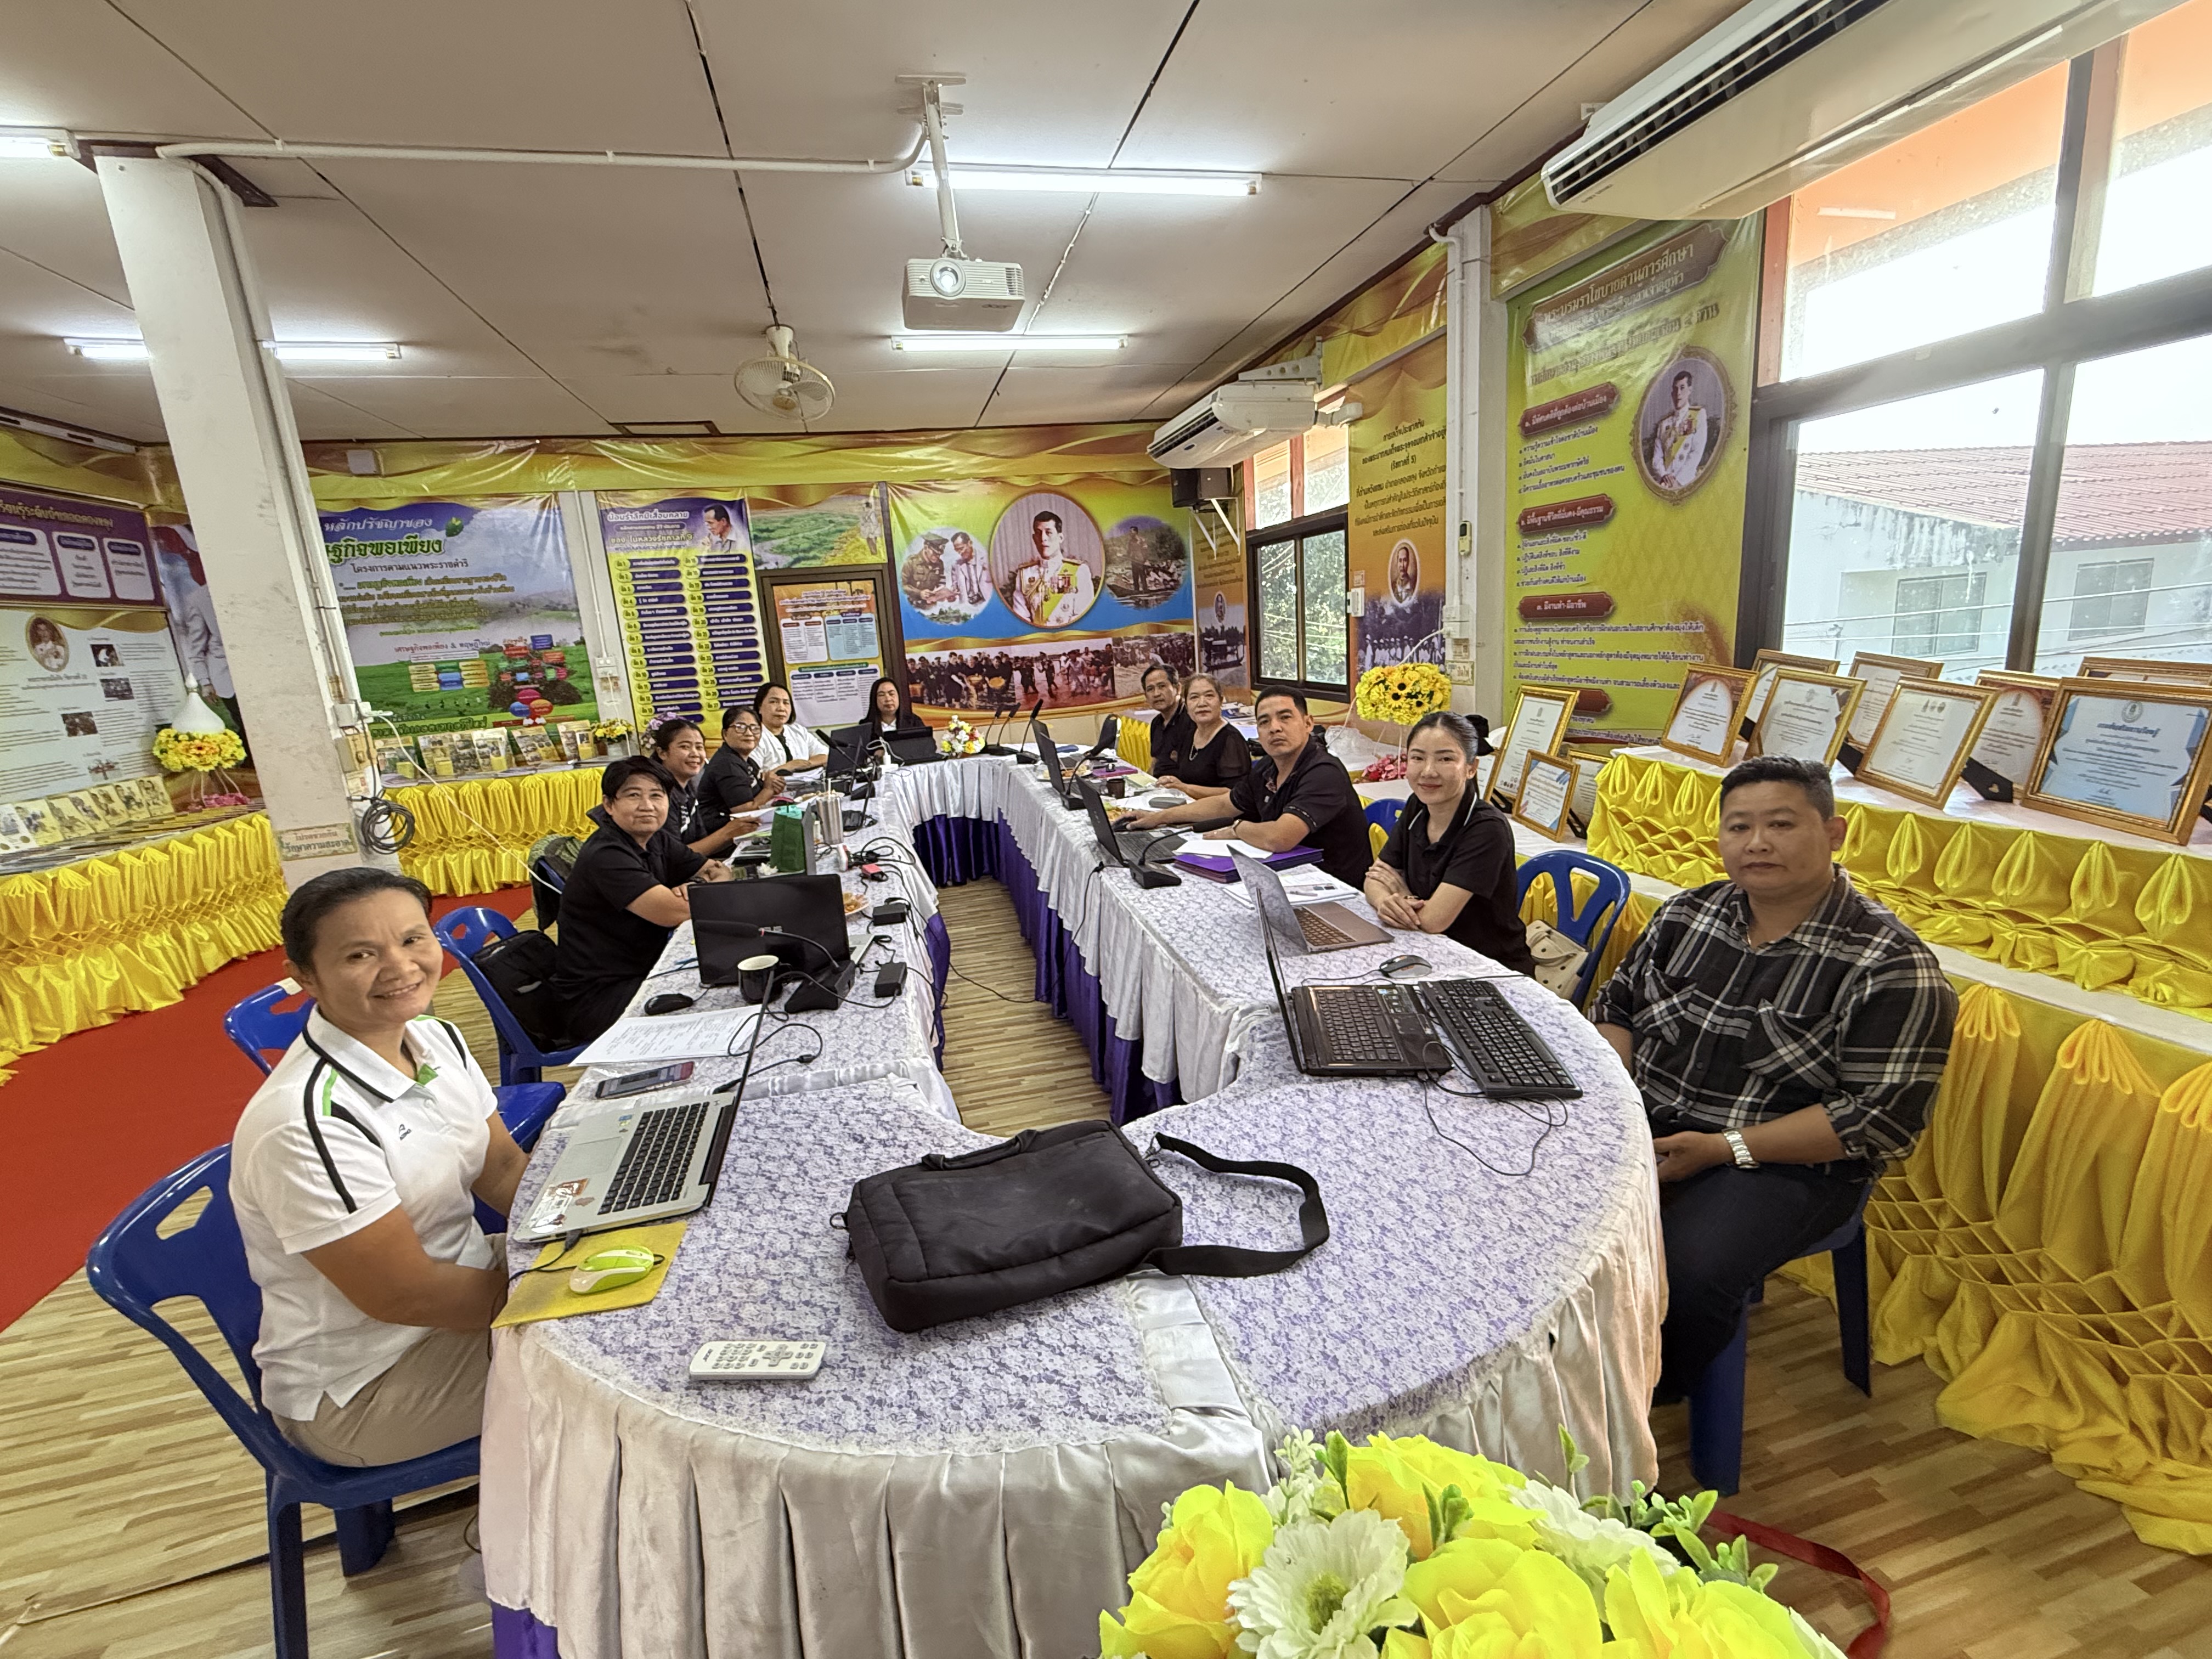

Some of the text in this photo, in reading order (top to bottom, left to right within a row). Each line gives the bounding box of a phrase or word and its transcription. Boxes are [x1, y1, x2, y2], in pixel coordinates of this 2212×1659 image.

[1544, 244, 1694, 323] พระบรมราโชบายด้านการศึกษา
[324, 517, 432, 533] หลักปรัชญาของ
